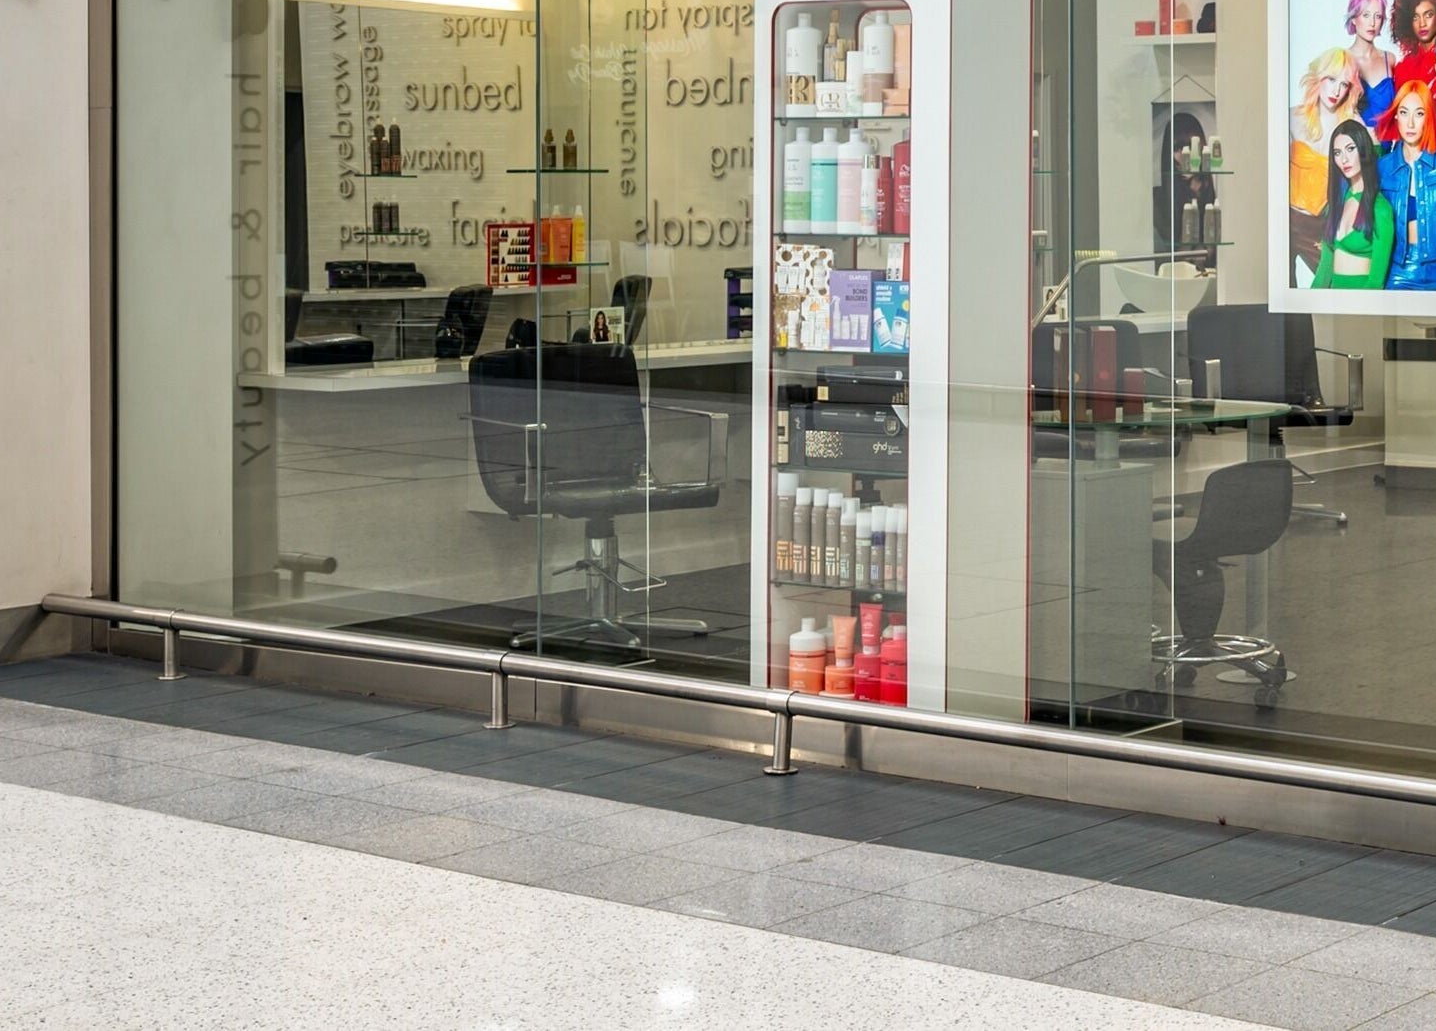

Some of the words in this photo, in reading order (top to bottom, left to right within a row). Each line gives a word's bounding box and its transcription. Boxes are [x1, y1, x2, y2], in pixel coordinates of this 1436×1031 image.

[403, 64, 523, 112] sunbed
[329, 52, 355, 199] eyebrow
[872, 441, 888, 455] ghd
